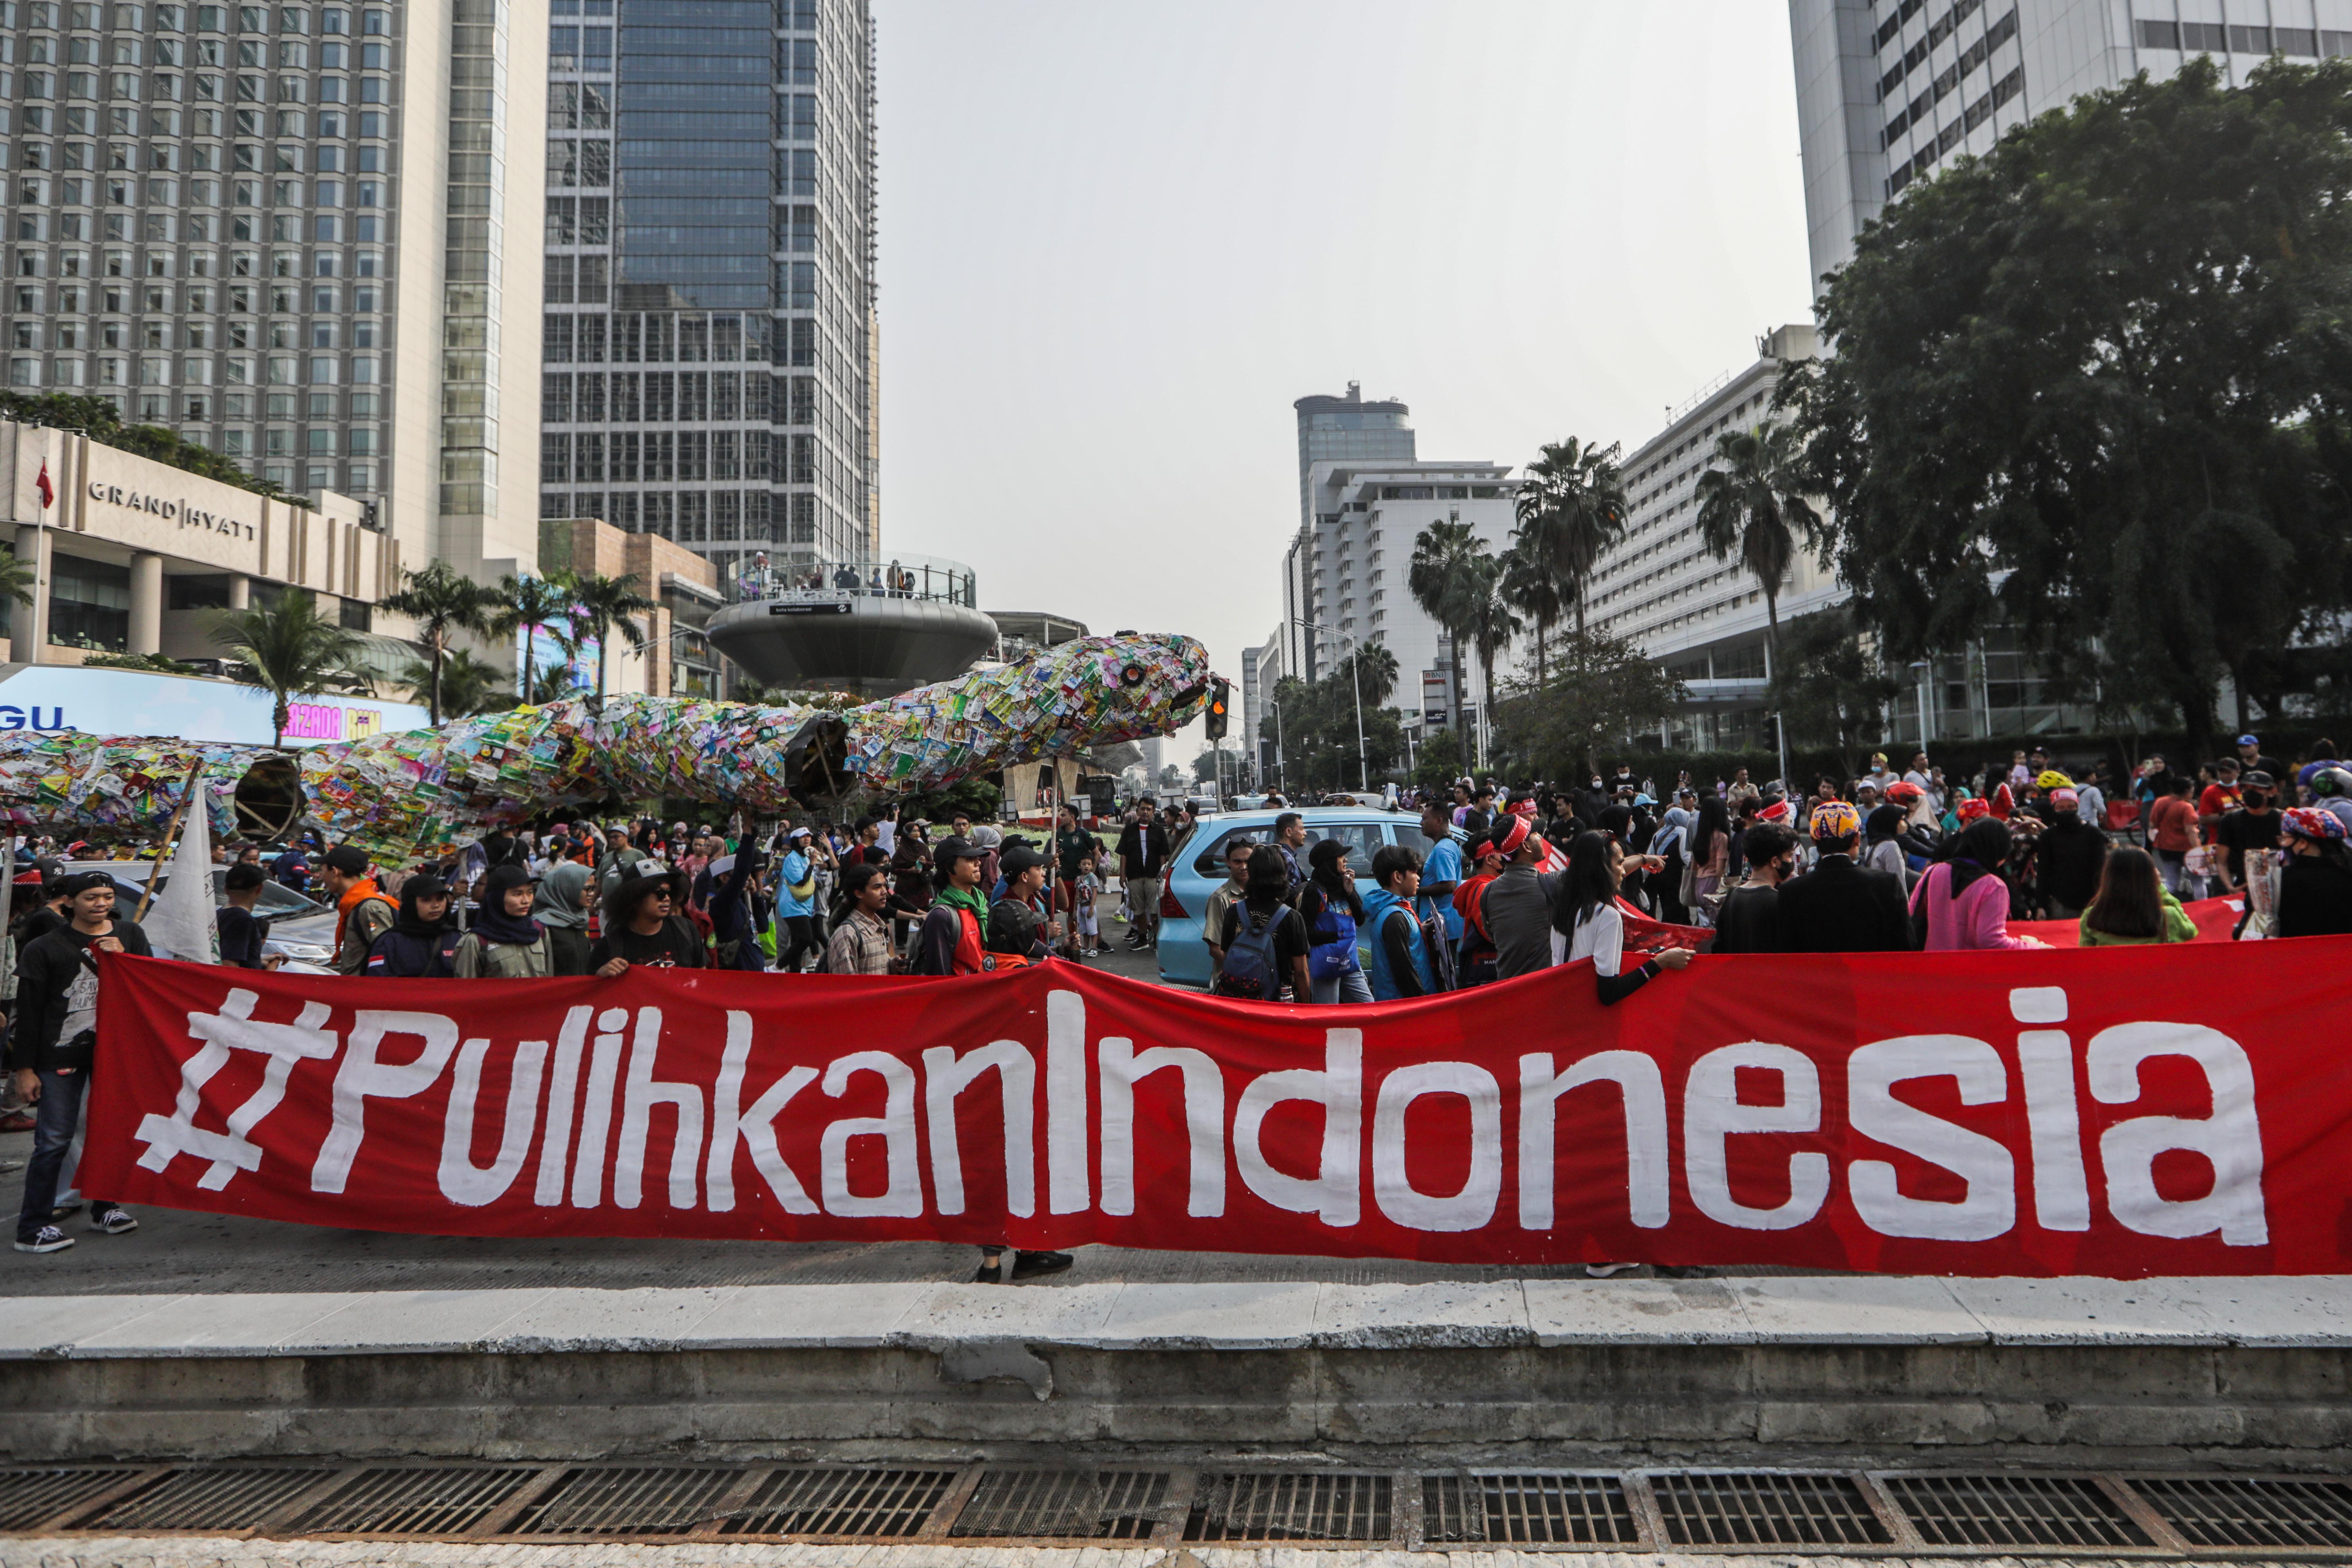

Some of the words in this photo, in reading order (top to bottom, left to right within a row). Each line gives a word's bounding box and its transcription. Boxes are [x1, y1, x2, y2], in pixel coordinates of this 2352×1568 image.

[89, 481, 176, 519] GRAND
[186, 507, 257, 541] HYATT
[135, 986, 2269, 1248] #PulihkanIndonesia
